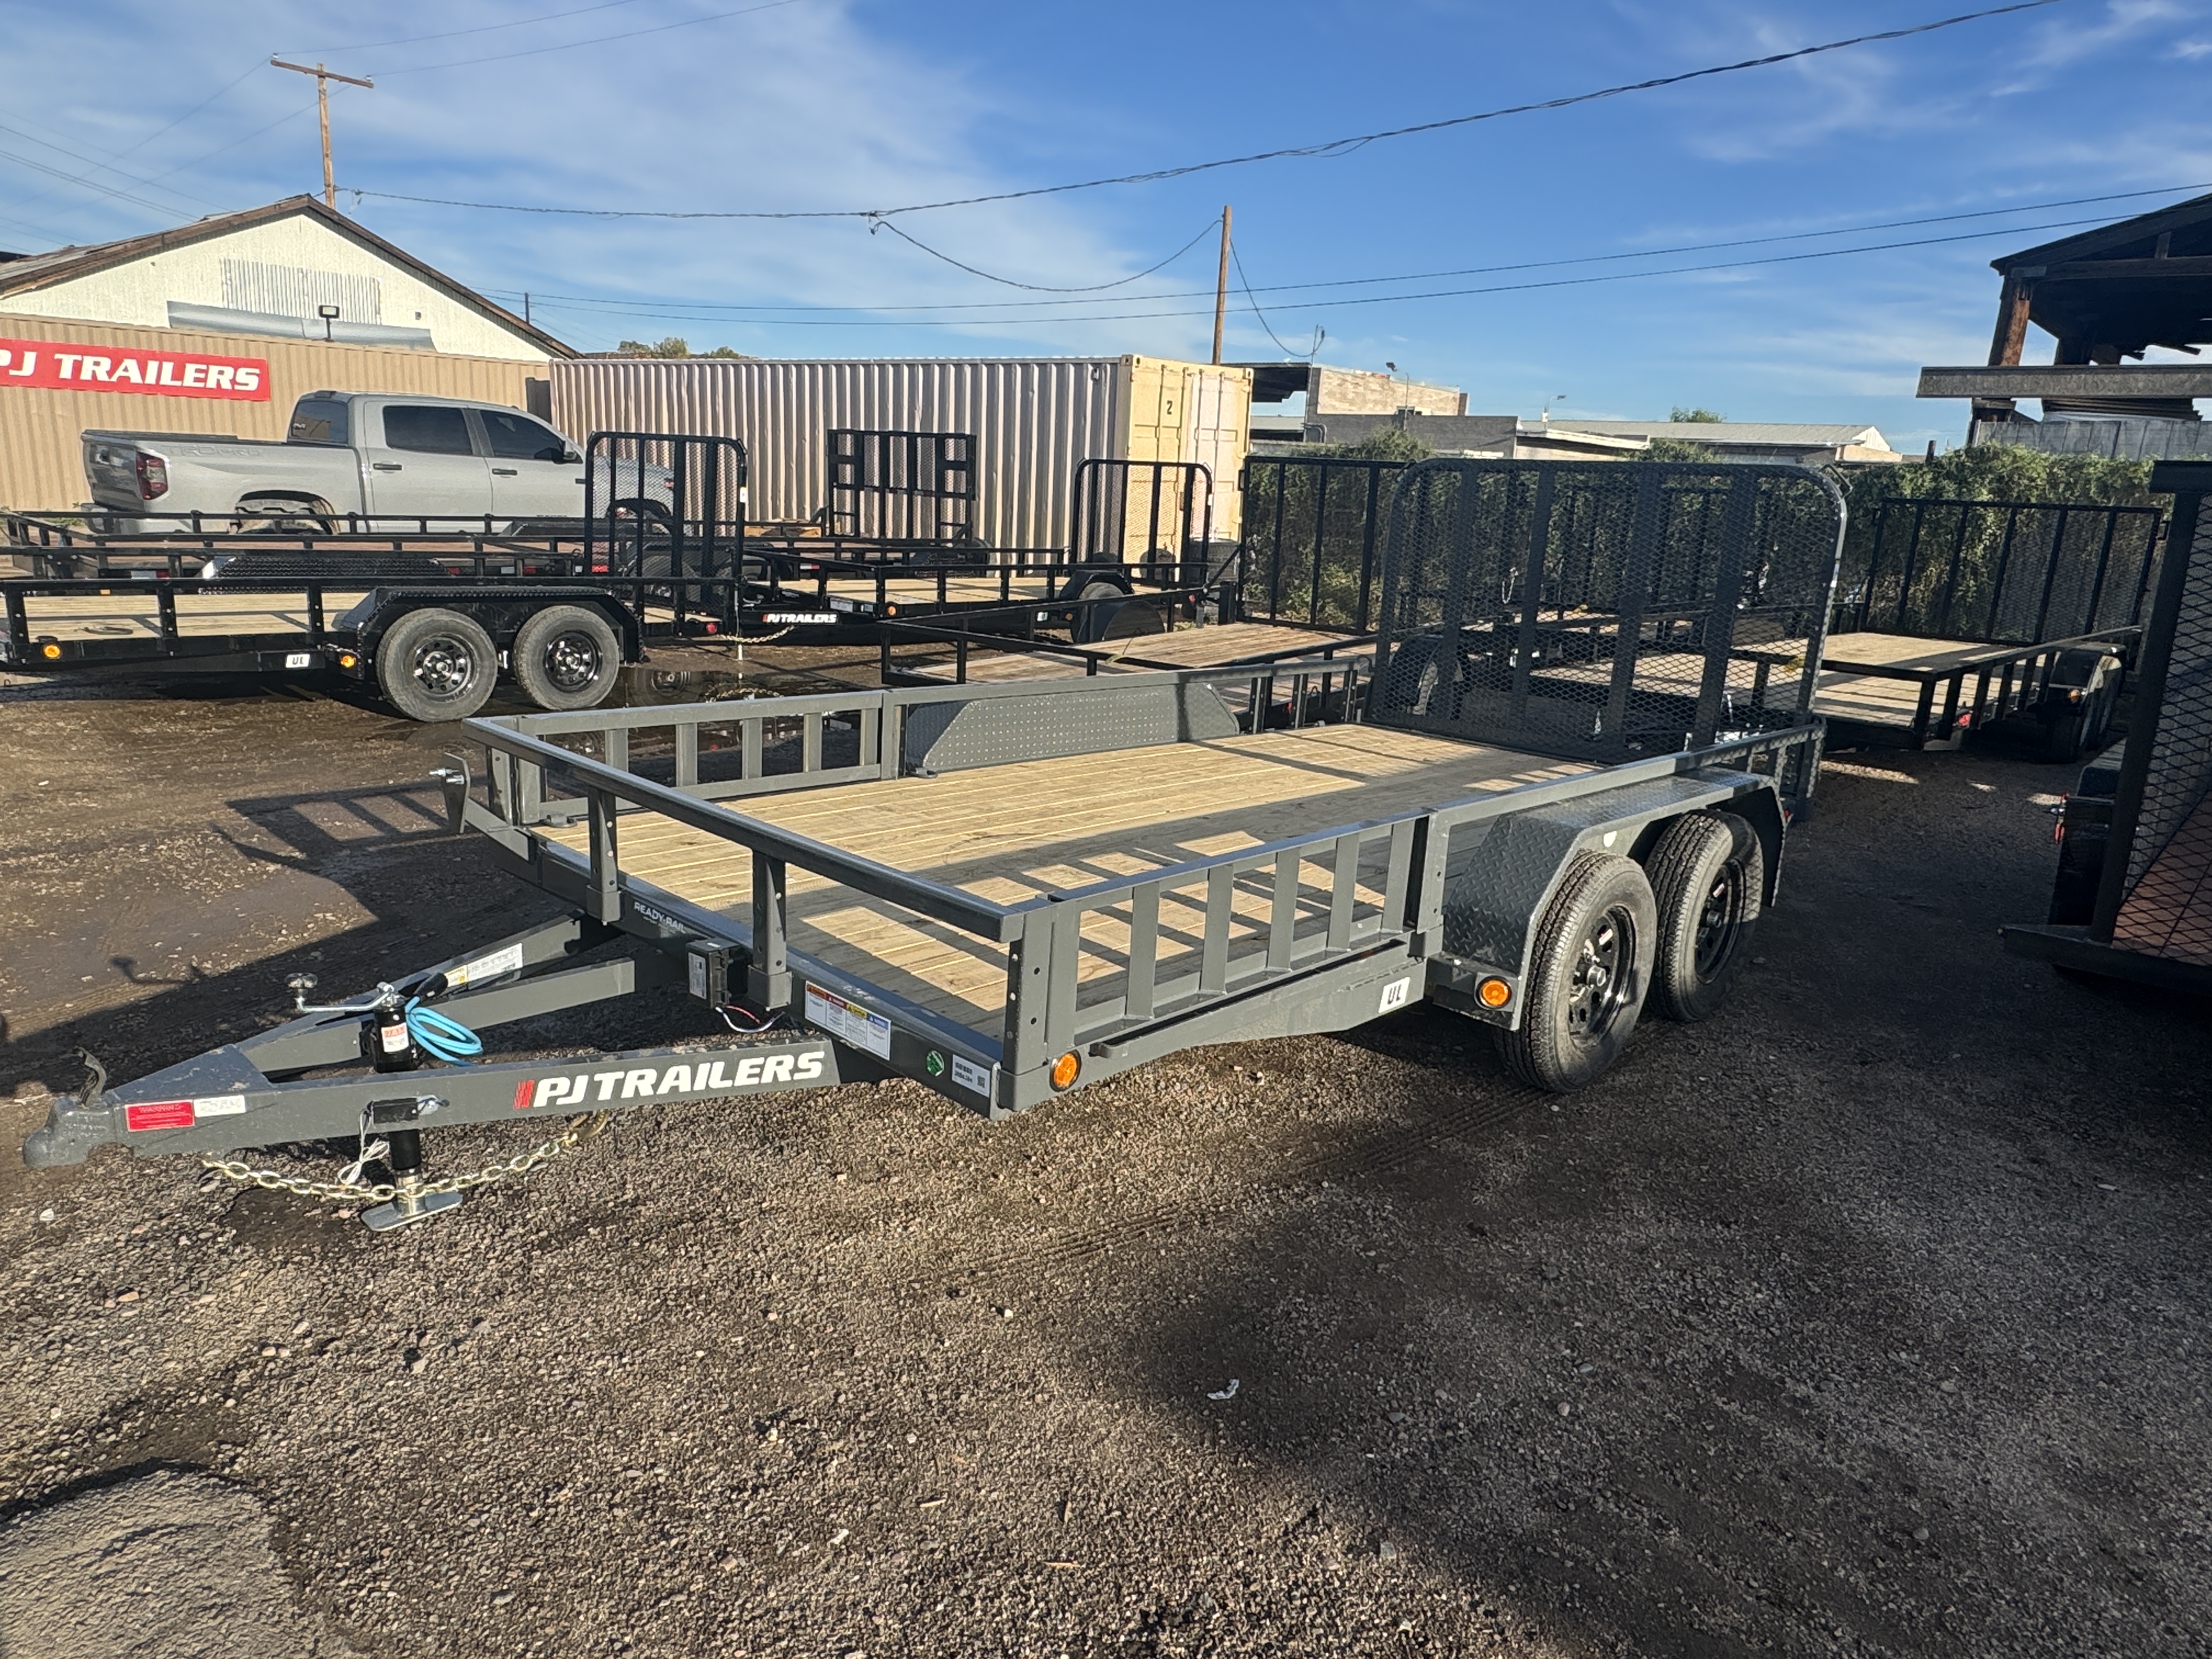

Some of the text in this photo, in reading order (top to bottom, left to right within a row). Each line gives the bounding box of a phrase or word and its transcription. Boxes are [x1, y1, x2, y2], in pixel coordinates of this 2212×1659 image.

[54, 353, 260, 391] TRAILERS
[1167, 400, 1173, 415] 2
[781, 613, 837, 623] TRAILERS
[1387, 984, 1402, 1005] UL
[533, 1051, 825, 1103] PJ TRAILERS
